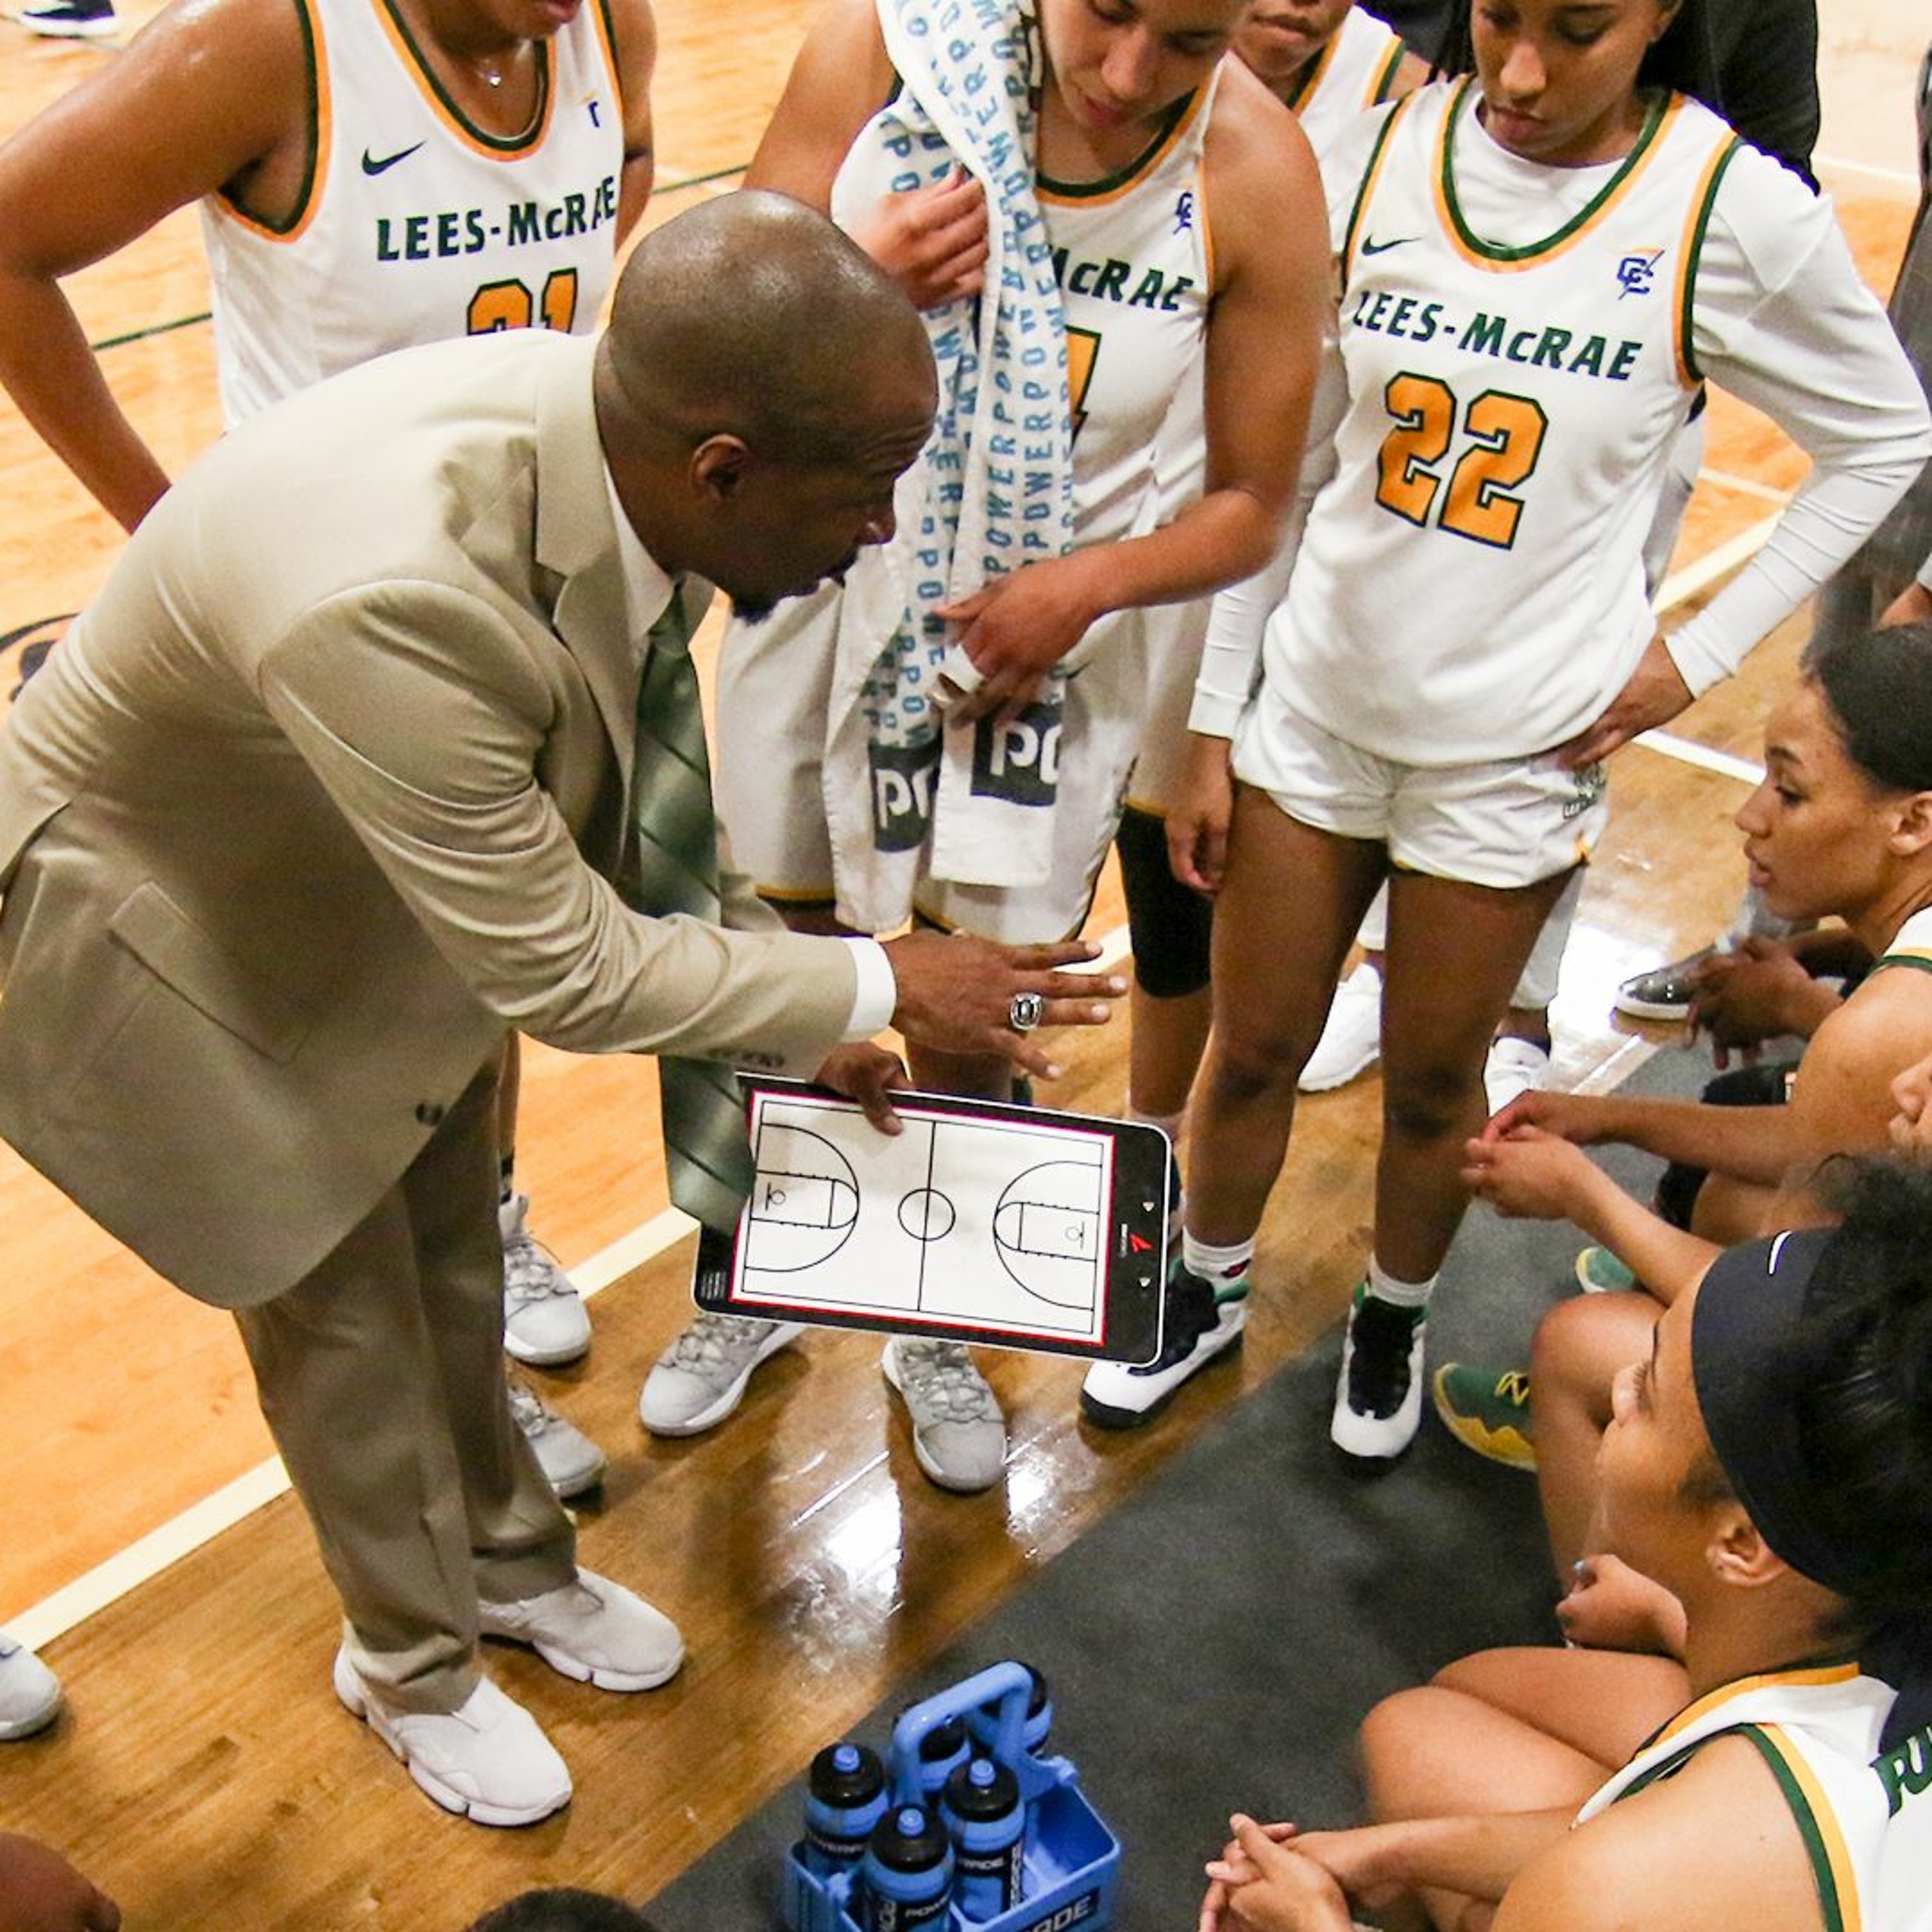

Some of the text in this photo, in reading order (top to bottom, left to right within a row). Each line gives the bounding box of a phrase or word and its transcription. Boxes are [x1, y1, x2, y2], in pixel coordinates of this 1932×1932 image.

[376, 175, 616, 261] LEES-McRAE
[1353, 290, 1643, 381] LEES-McRAE
[1375, 370, 1549, 551] 22
